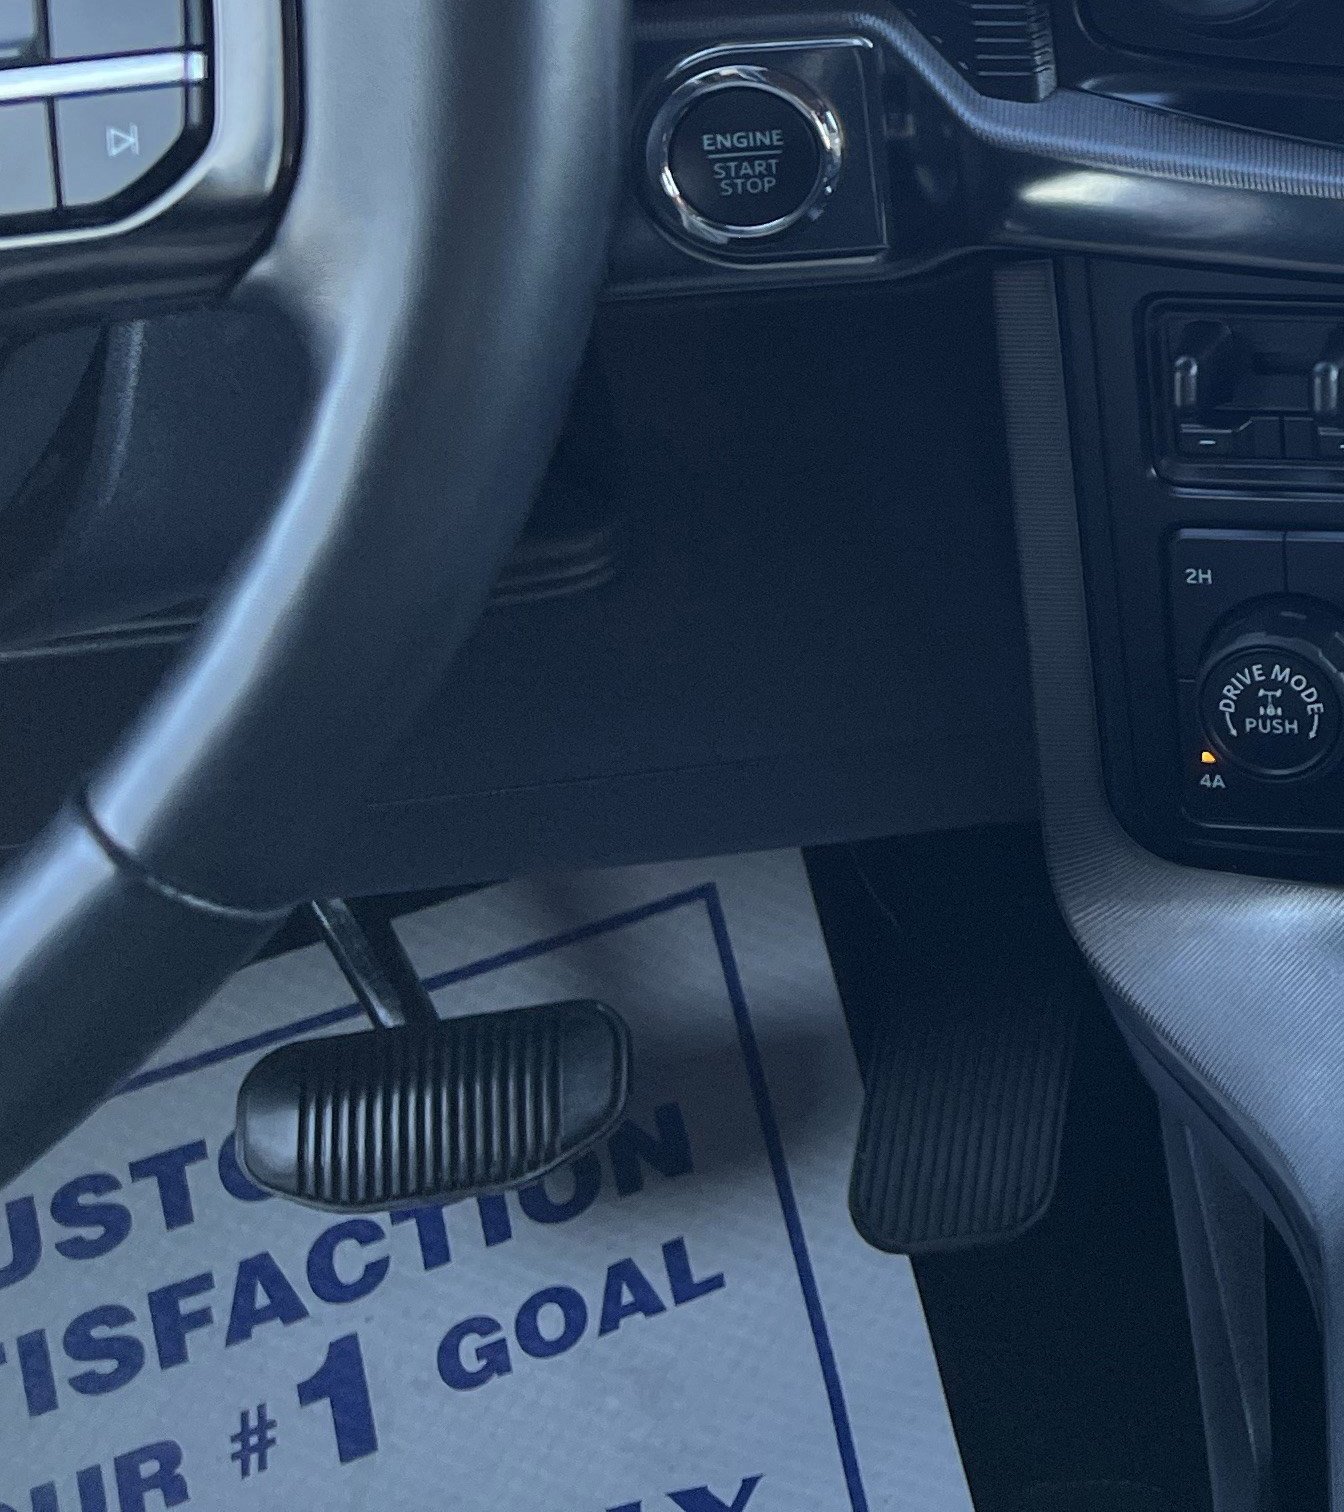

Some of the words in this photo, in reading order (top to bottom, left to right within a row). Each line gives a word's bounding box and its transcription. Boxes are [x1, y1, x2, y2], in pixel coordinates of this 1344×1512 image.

[702, 130, 785, 152] ENGINE
[713, 159, 779, 179] START
[720, 178, 776, 196] STOP
[1185, 567, 1213, 586] 2H
[1218, 665, 1267, 714] DRIVE
[1270, 665, 1325, 716] MODE
[1245, 717, 1299, 736] PUSH
[1200, 774, 1226, 790] 4A
[0, 1102, 697, 1418] ISFACTION
[436, 1237, 726, 1390] GOAL
